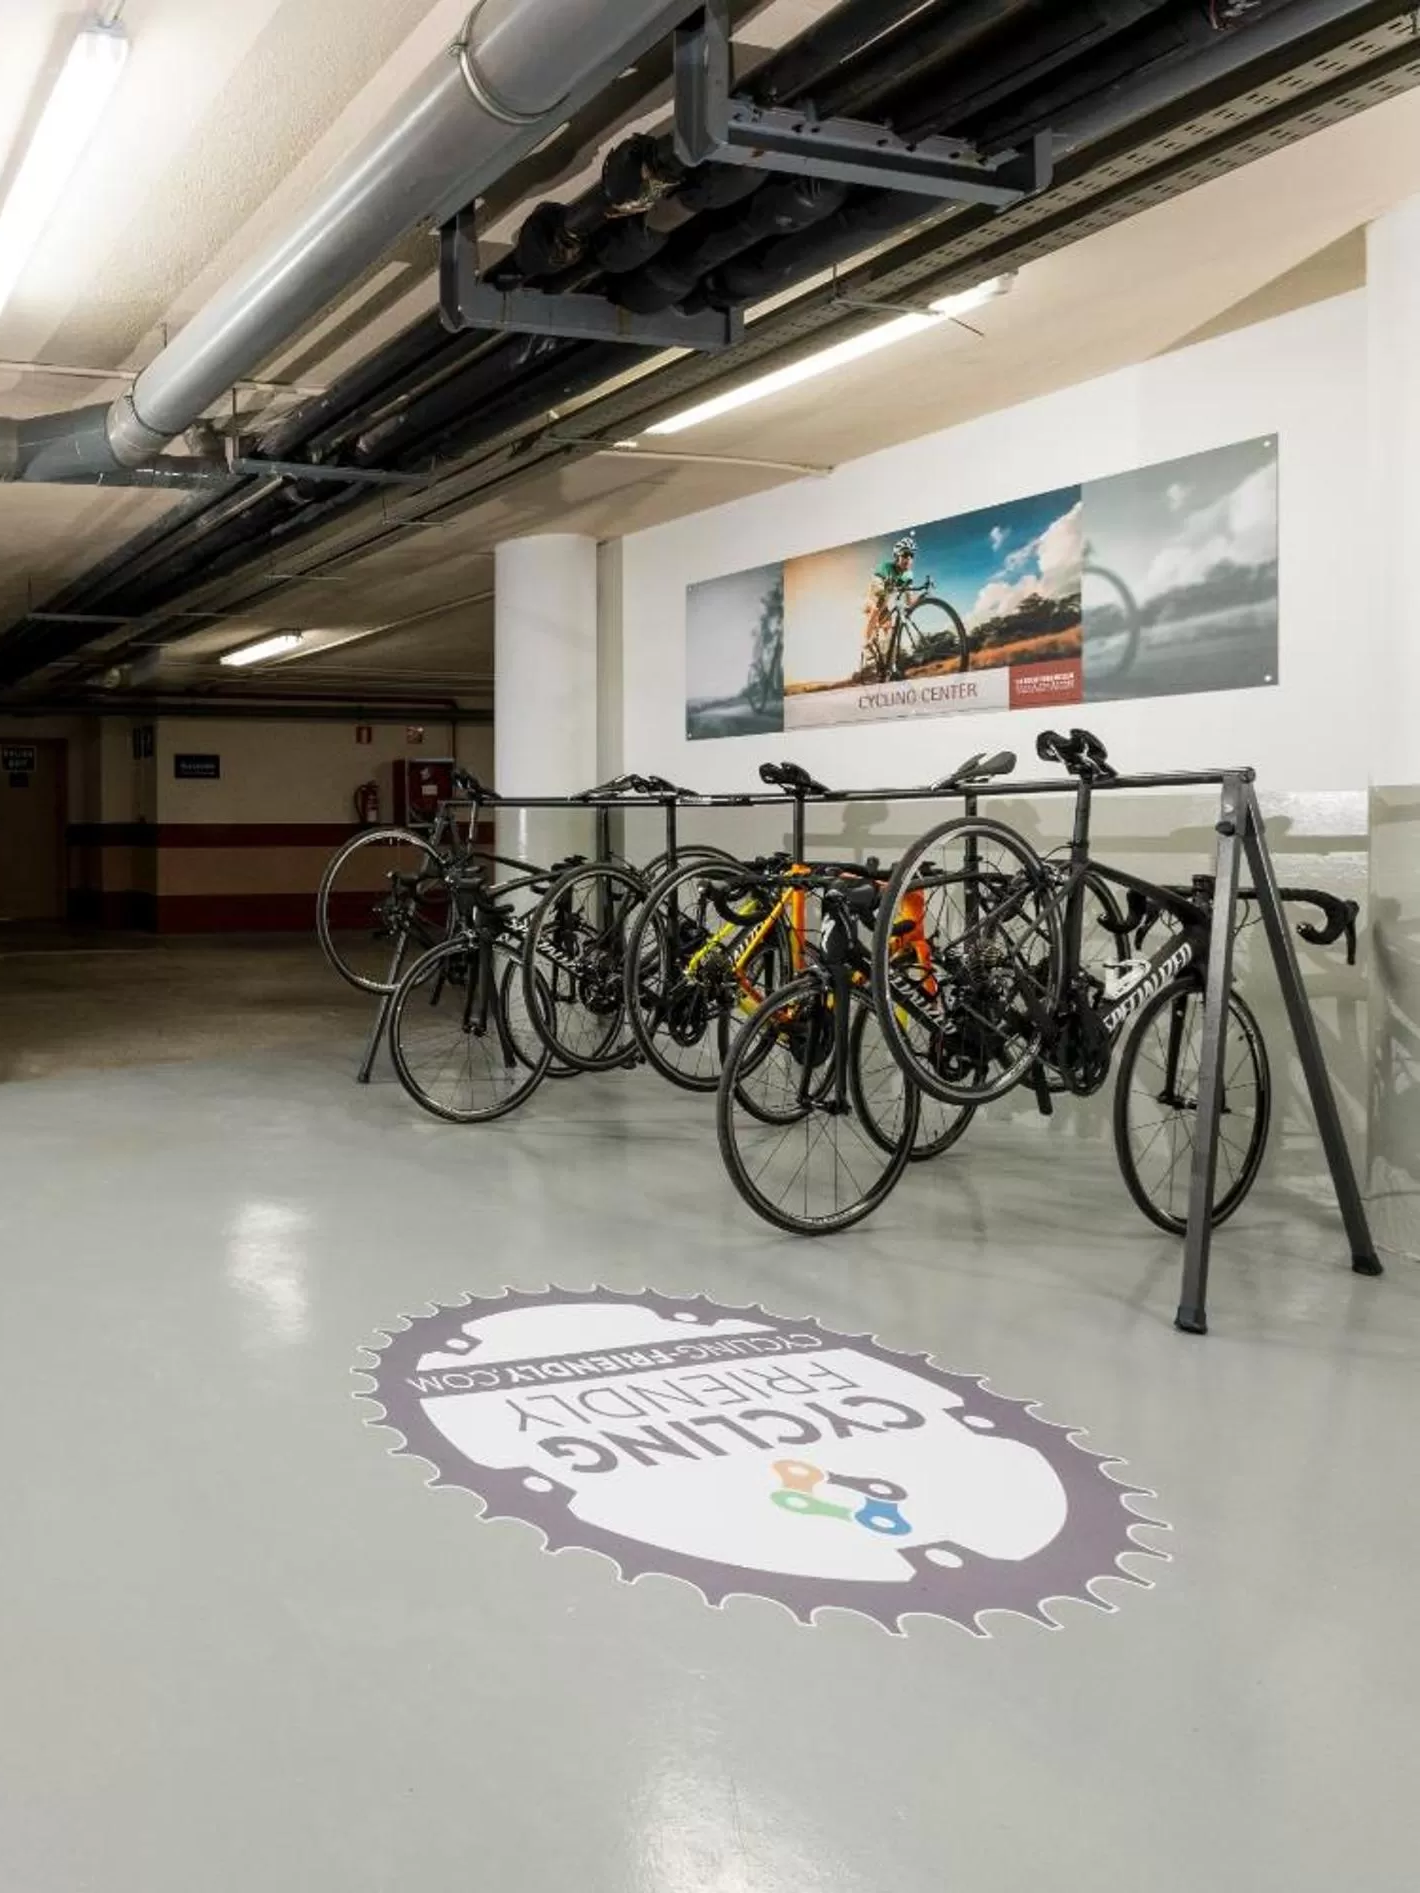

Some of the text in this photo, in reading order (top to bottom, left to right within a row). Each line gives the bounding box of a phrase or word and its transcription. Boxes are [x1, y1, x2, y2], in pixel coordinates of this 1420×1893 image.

[858, 682, 978, 709] CYCLING CENTER
[1102, 941, 1193, 1033] SPECIALIZED
[407, 1332, 824, 1393] CYCLING-FRIENDLY.COM
[506, 1361, 860, 1433] FRIENDLY
[537, 1396, 926, 1474] CYCLING
